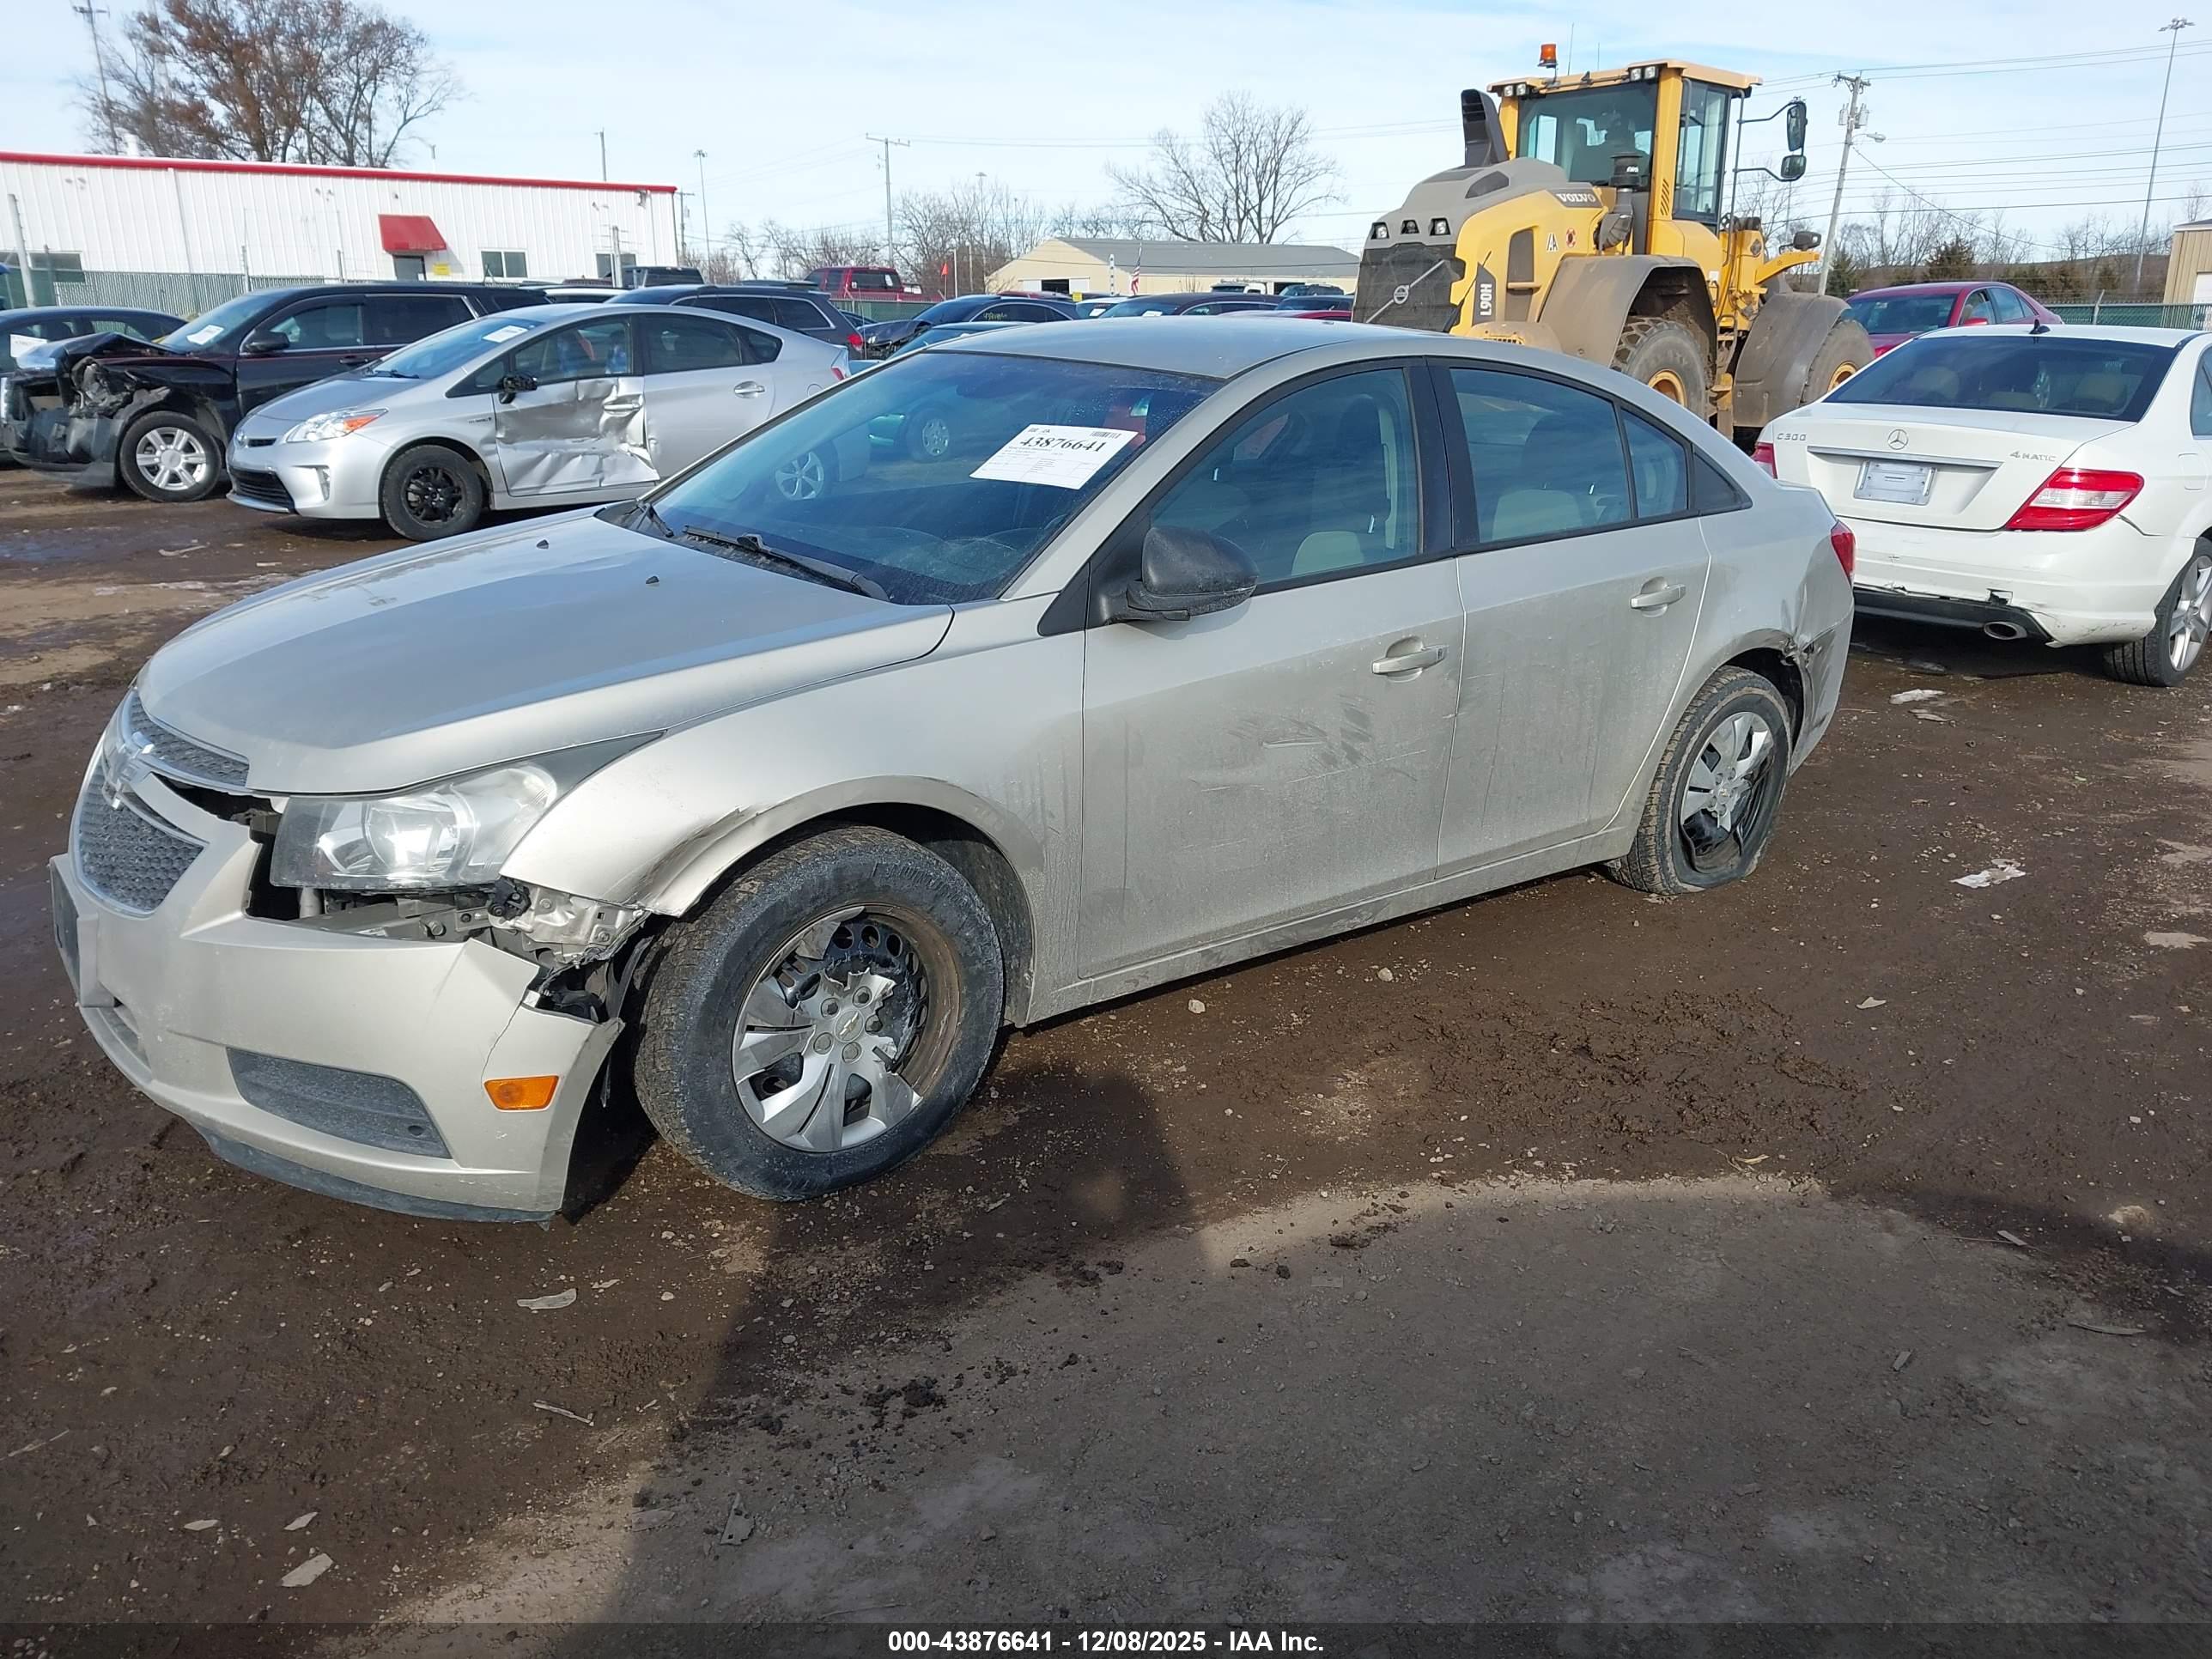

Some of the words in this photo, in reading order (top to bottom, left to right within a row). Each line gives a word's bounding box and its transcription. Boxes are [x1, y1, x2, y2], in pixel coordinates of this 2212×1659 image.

[1555, 192, 1596, 203] VOLVO
[1480, 283, 1492, 316] L90H
[1020, 436, 1107, 453] 43876641
